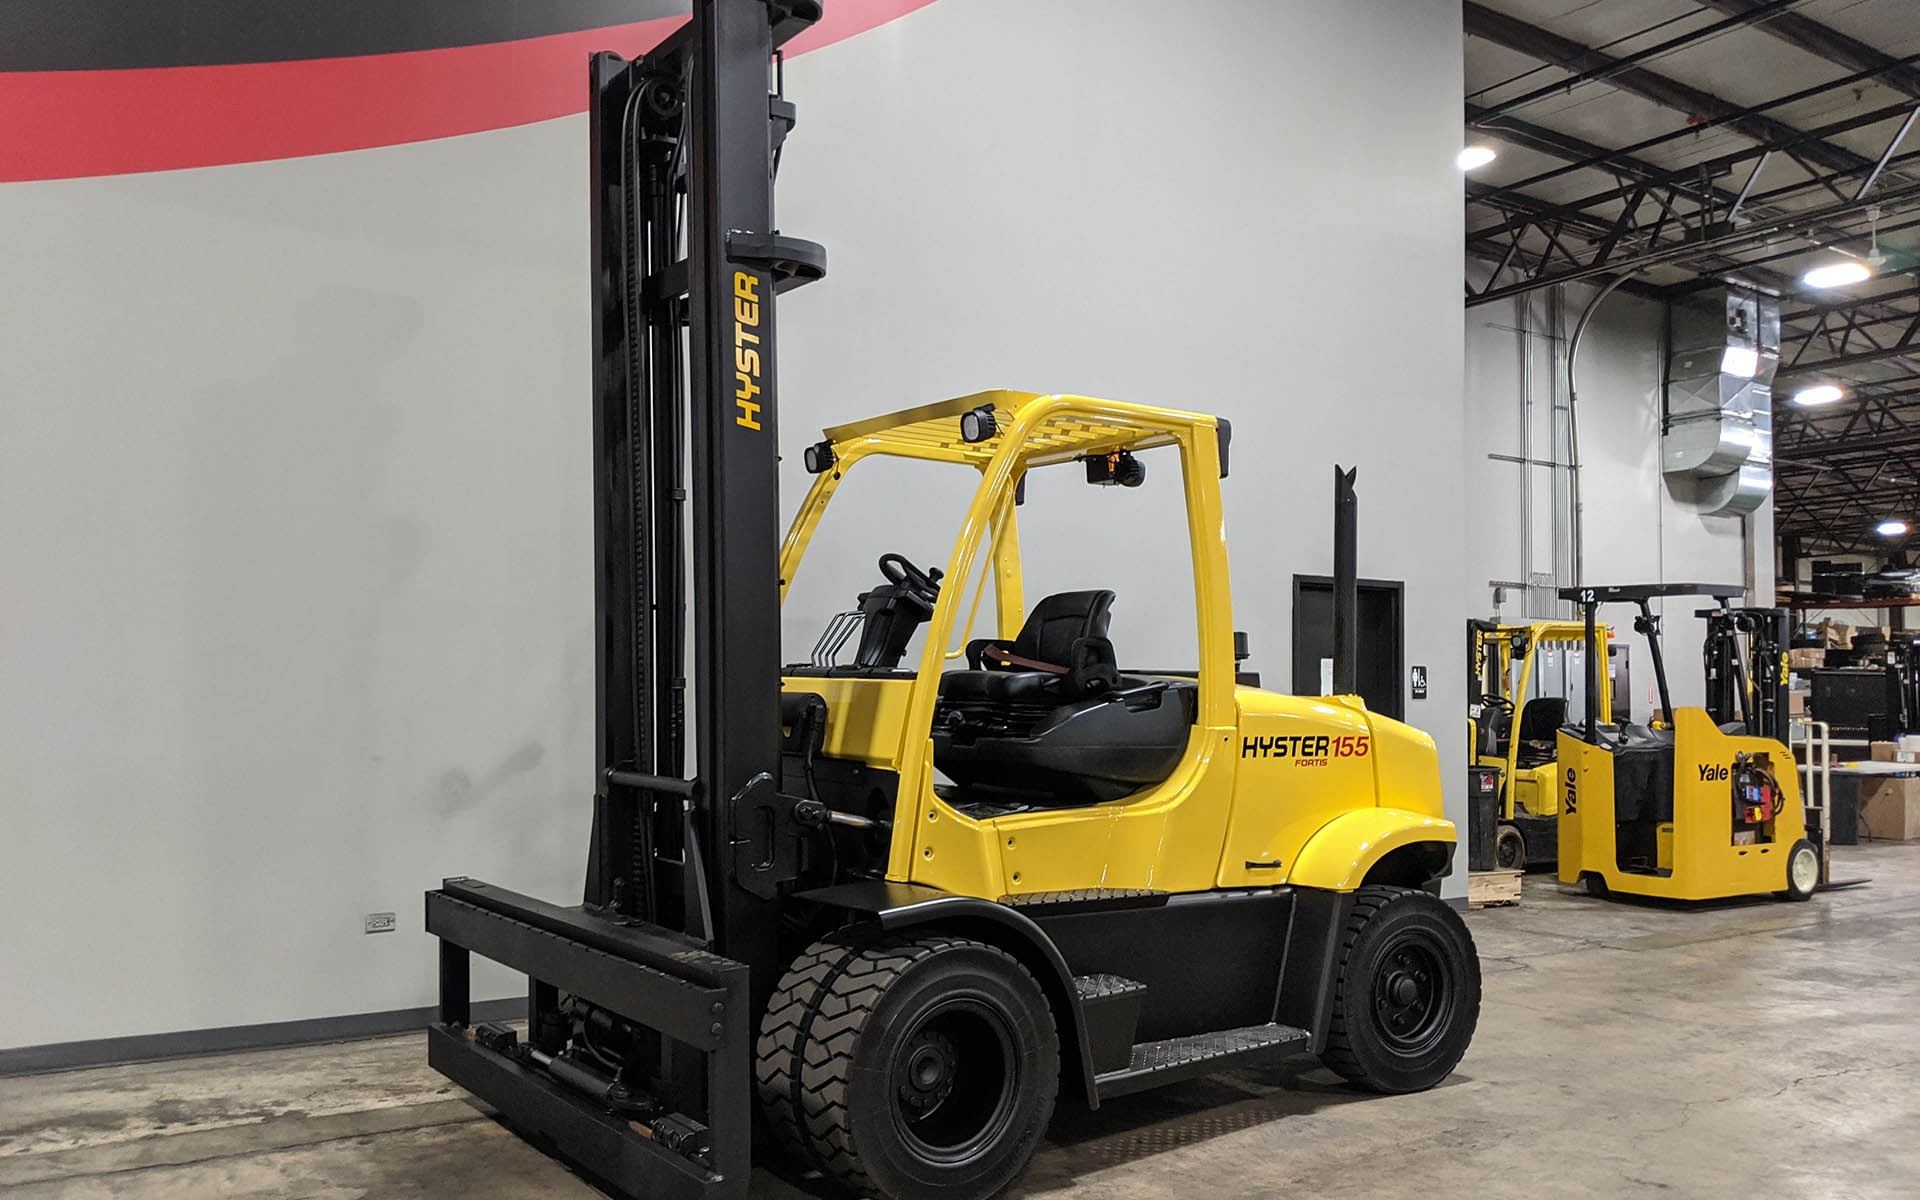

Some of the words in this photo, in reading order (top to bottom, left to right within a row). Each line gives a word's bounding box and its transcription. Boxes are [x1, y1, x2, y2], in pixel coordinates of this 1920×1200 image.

[734, 271, 761, 431] HYSTER
[1580, 589, 1595, 602] 12
[1474, 629, 1484, 677] HYSTER
[1780, 651, 1789, 686] Yale
[1241, 735, 1330, 759] HYSTER
[1331, 735, 1370, 758] 155
[1294, 758, 1328, 768] FORTIS
[1697, 763, 1729, 781] Yale
[1564, 767, 1577, 815] Yale
